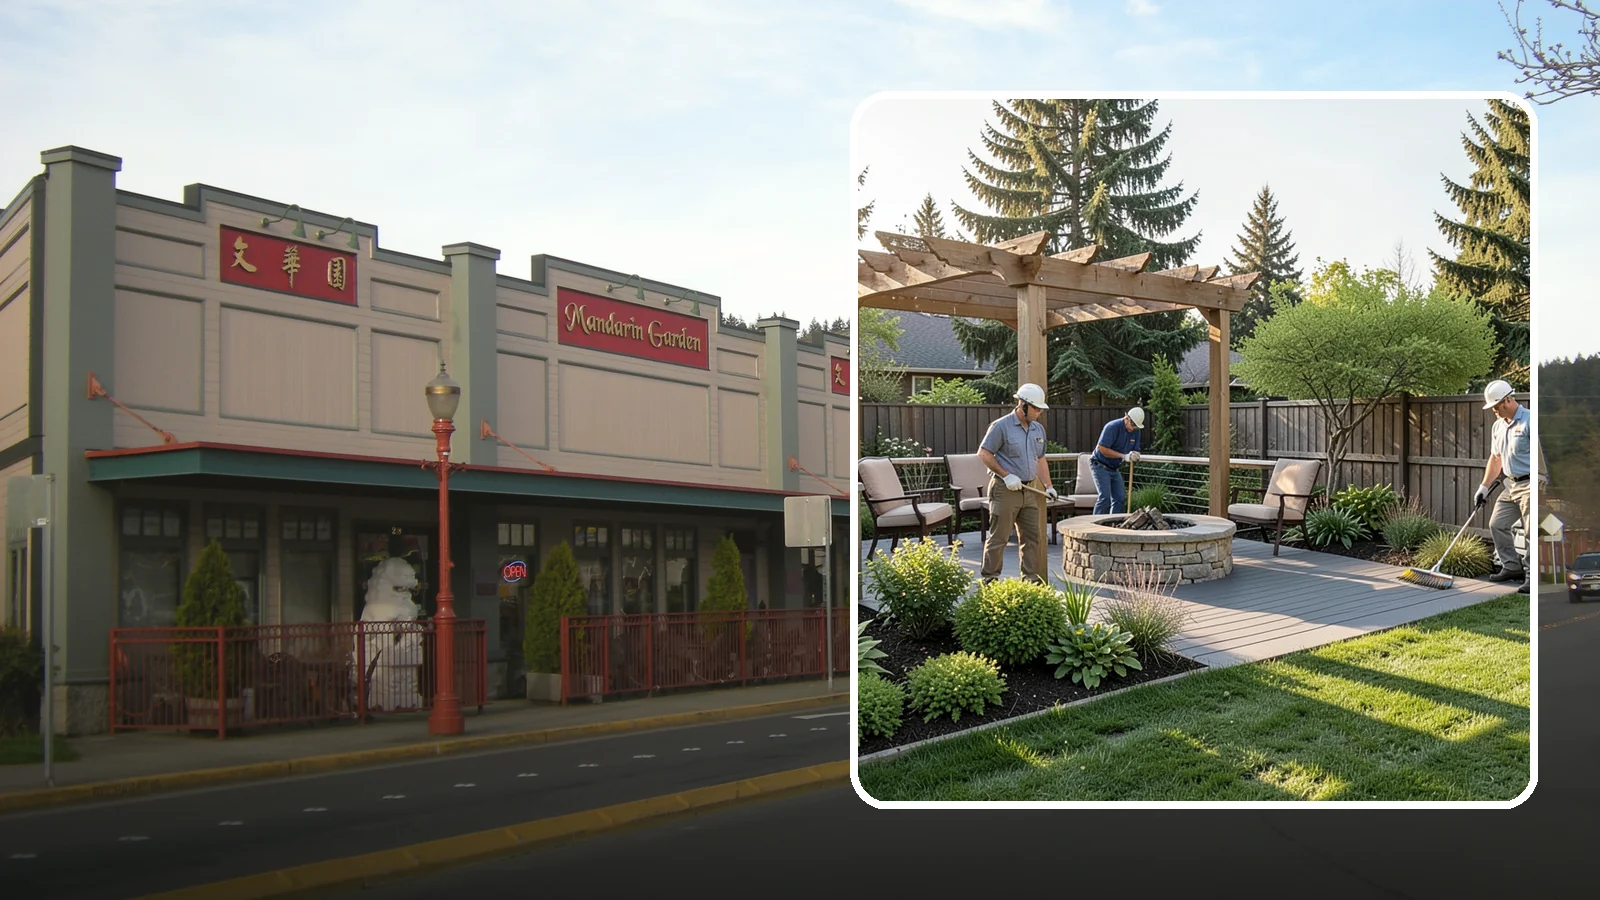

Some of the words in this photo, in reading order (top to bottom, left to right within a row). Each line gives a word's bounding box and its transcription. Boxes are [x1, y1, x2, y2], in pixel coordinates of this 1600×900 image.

[231, 236, 346, 290] 文華園
[564, 303, 644, 341] Mandarin
[648, 320, 701, 352] Garden
[503, 565, 527, 578] OPEN
